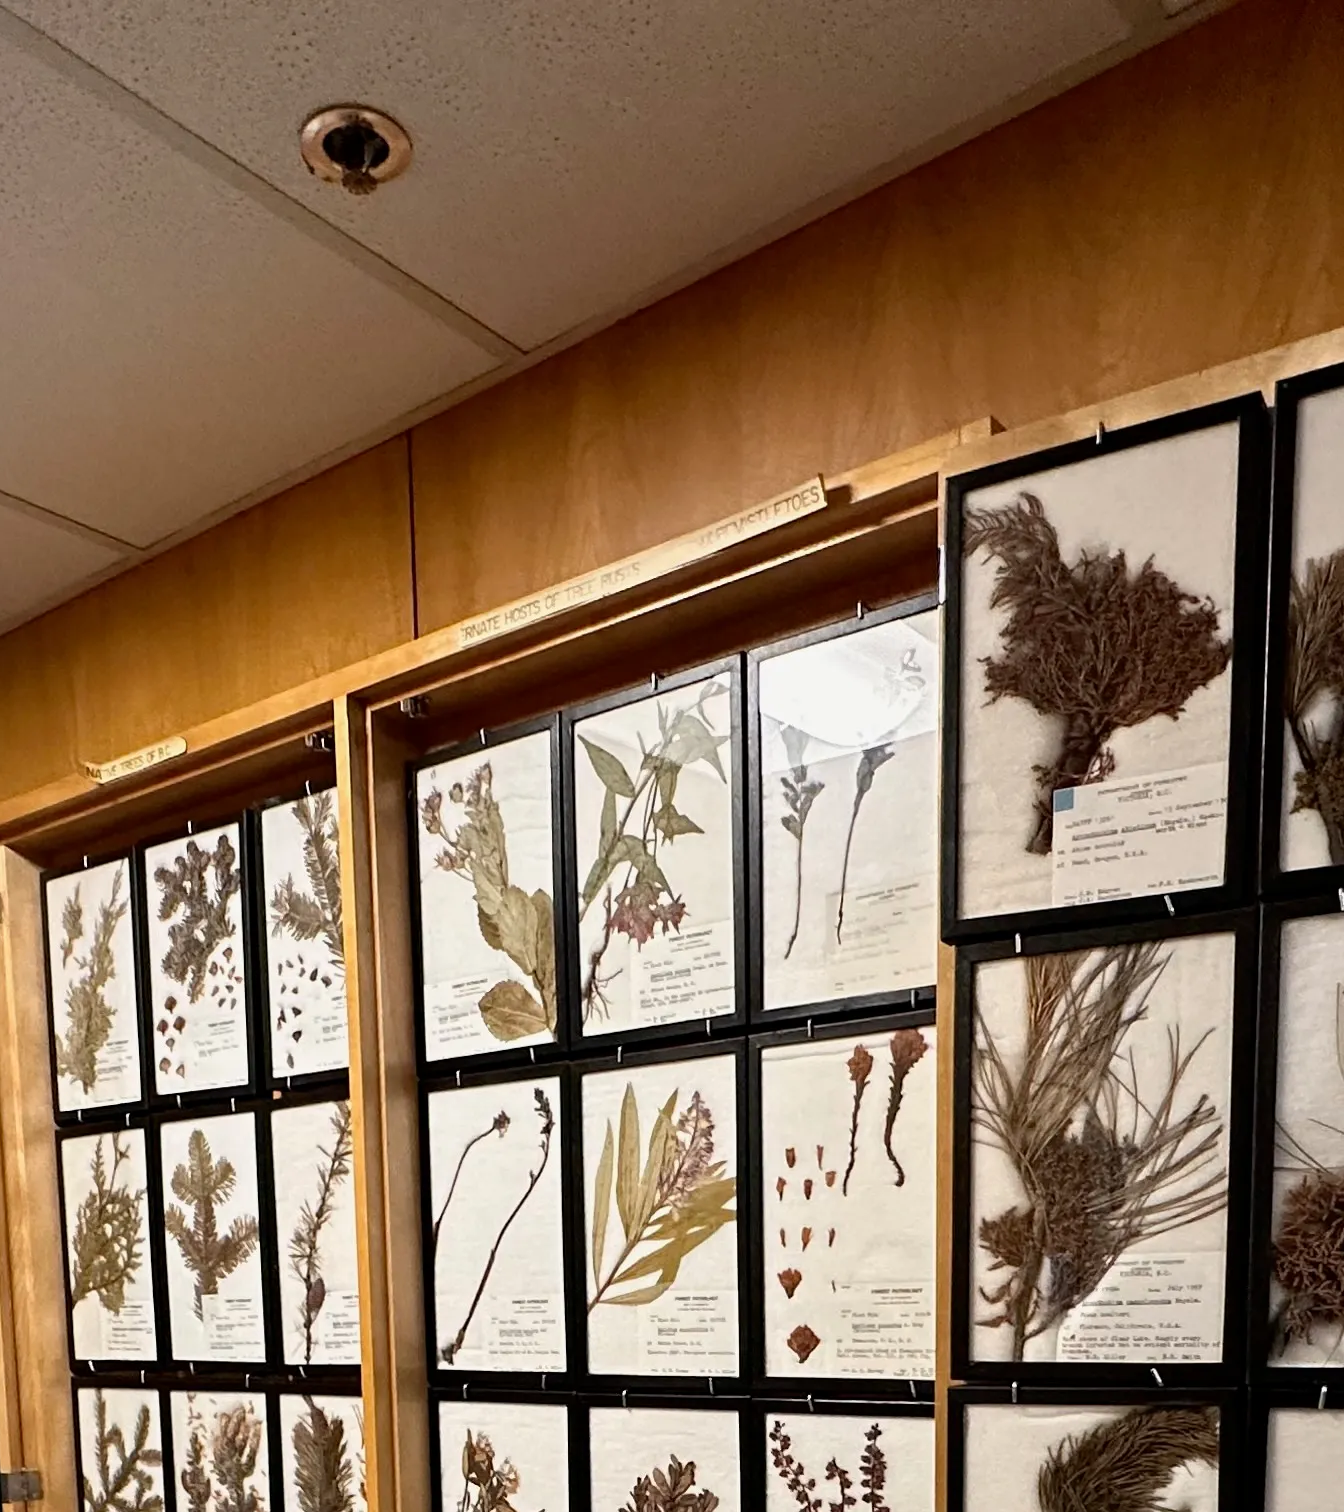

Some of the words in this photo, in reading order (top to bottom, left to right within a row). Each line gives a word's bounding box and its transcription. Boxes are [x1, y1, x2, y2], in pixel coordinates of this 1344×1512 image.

[504, 600, 541, 625] HOSTS
[545, 591, 560, 610] OF
[146, 750, 155, 763] OF
